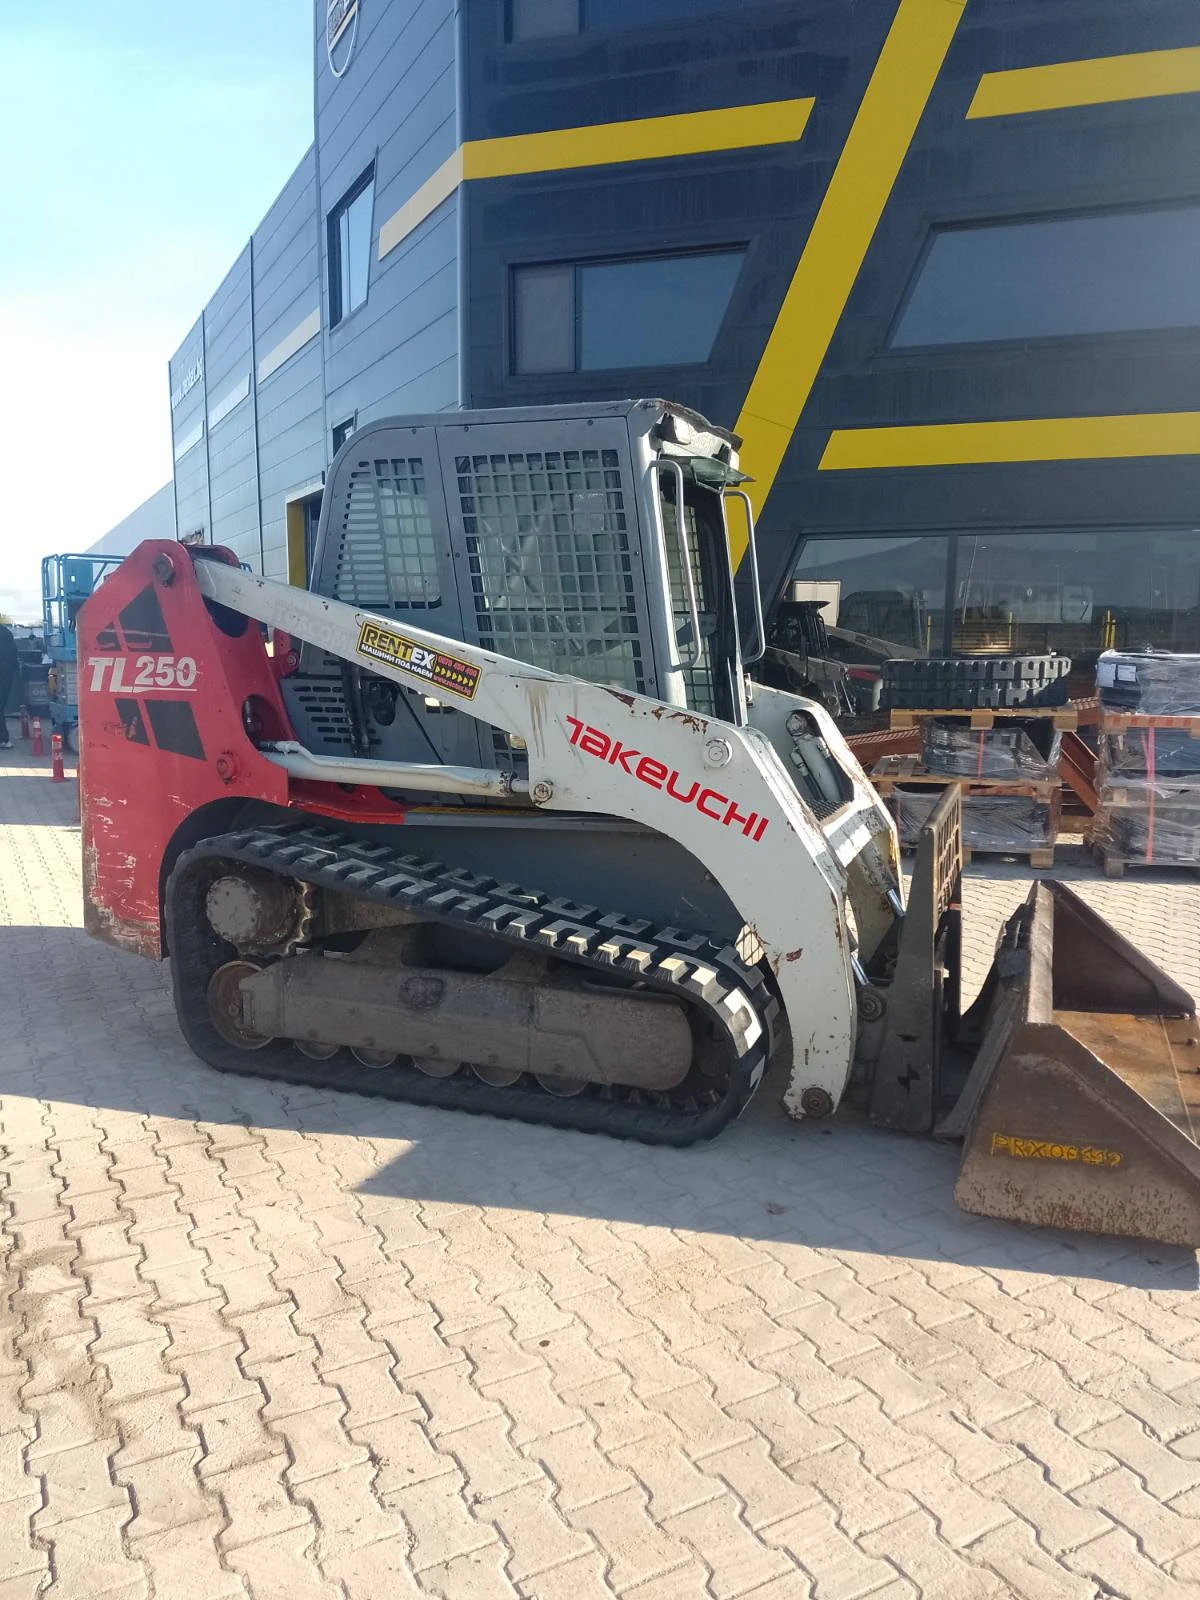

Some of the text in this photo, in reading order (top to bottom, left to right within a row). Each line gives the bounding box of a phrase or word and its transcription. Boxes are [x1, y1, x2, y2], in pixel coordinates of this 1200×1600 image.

[361, 643, 433, 679] МАШИНИ ПОД НАЕМ
[364, 628, 436, 669] RENTEX
[88, 655, 198, 693] TL250
